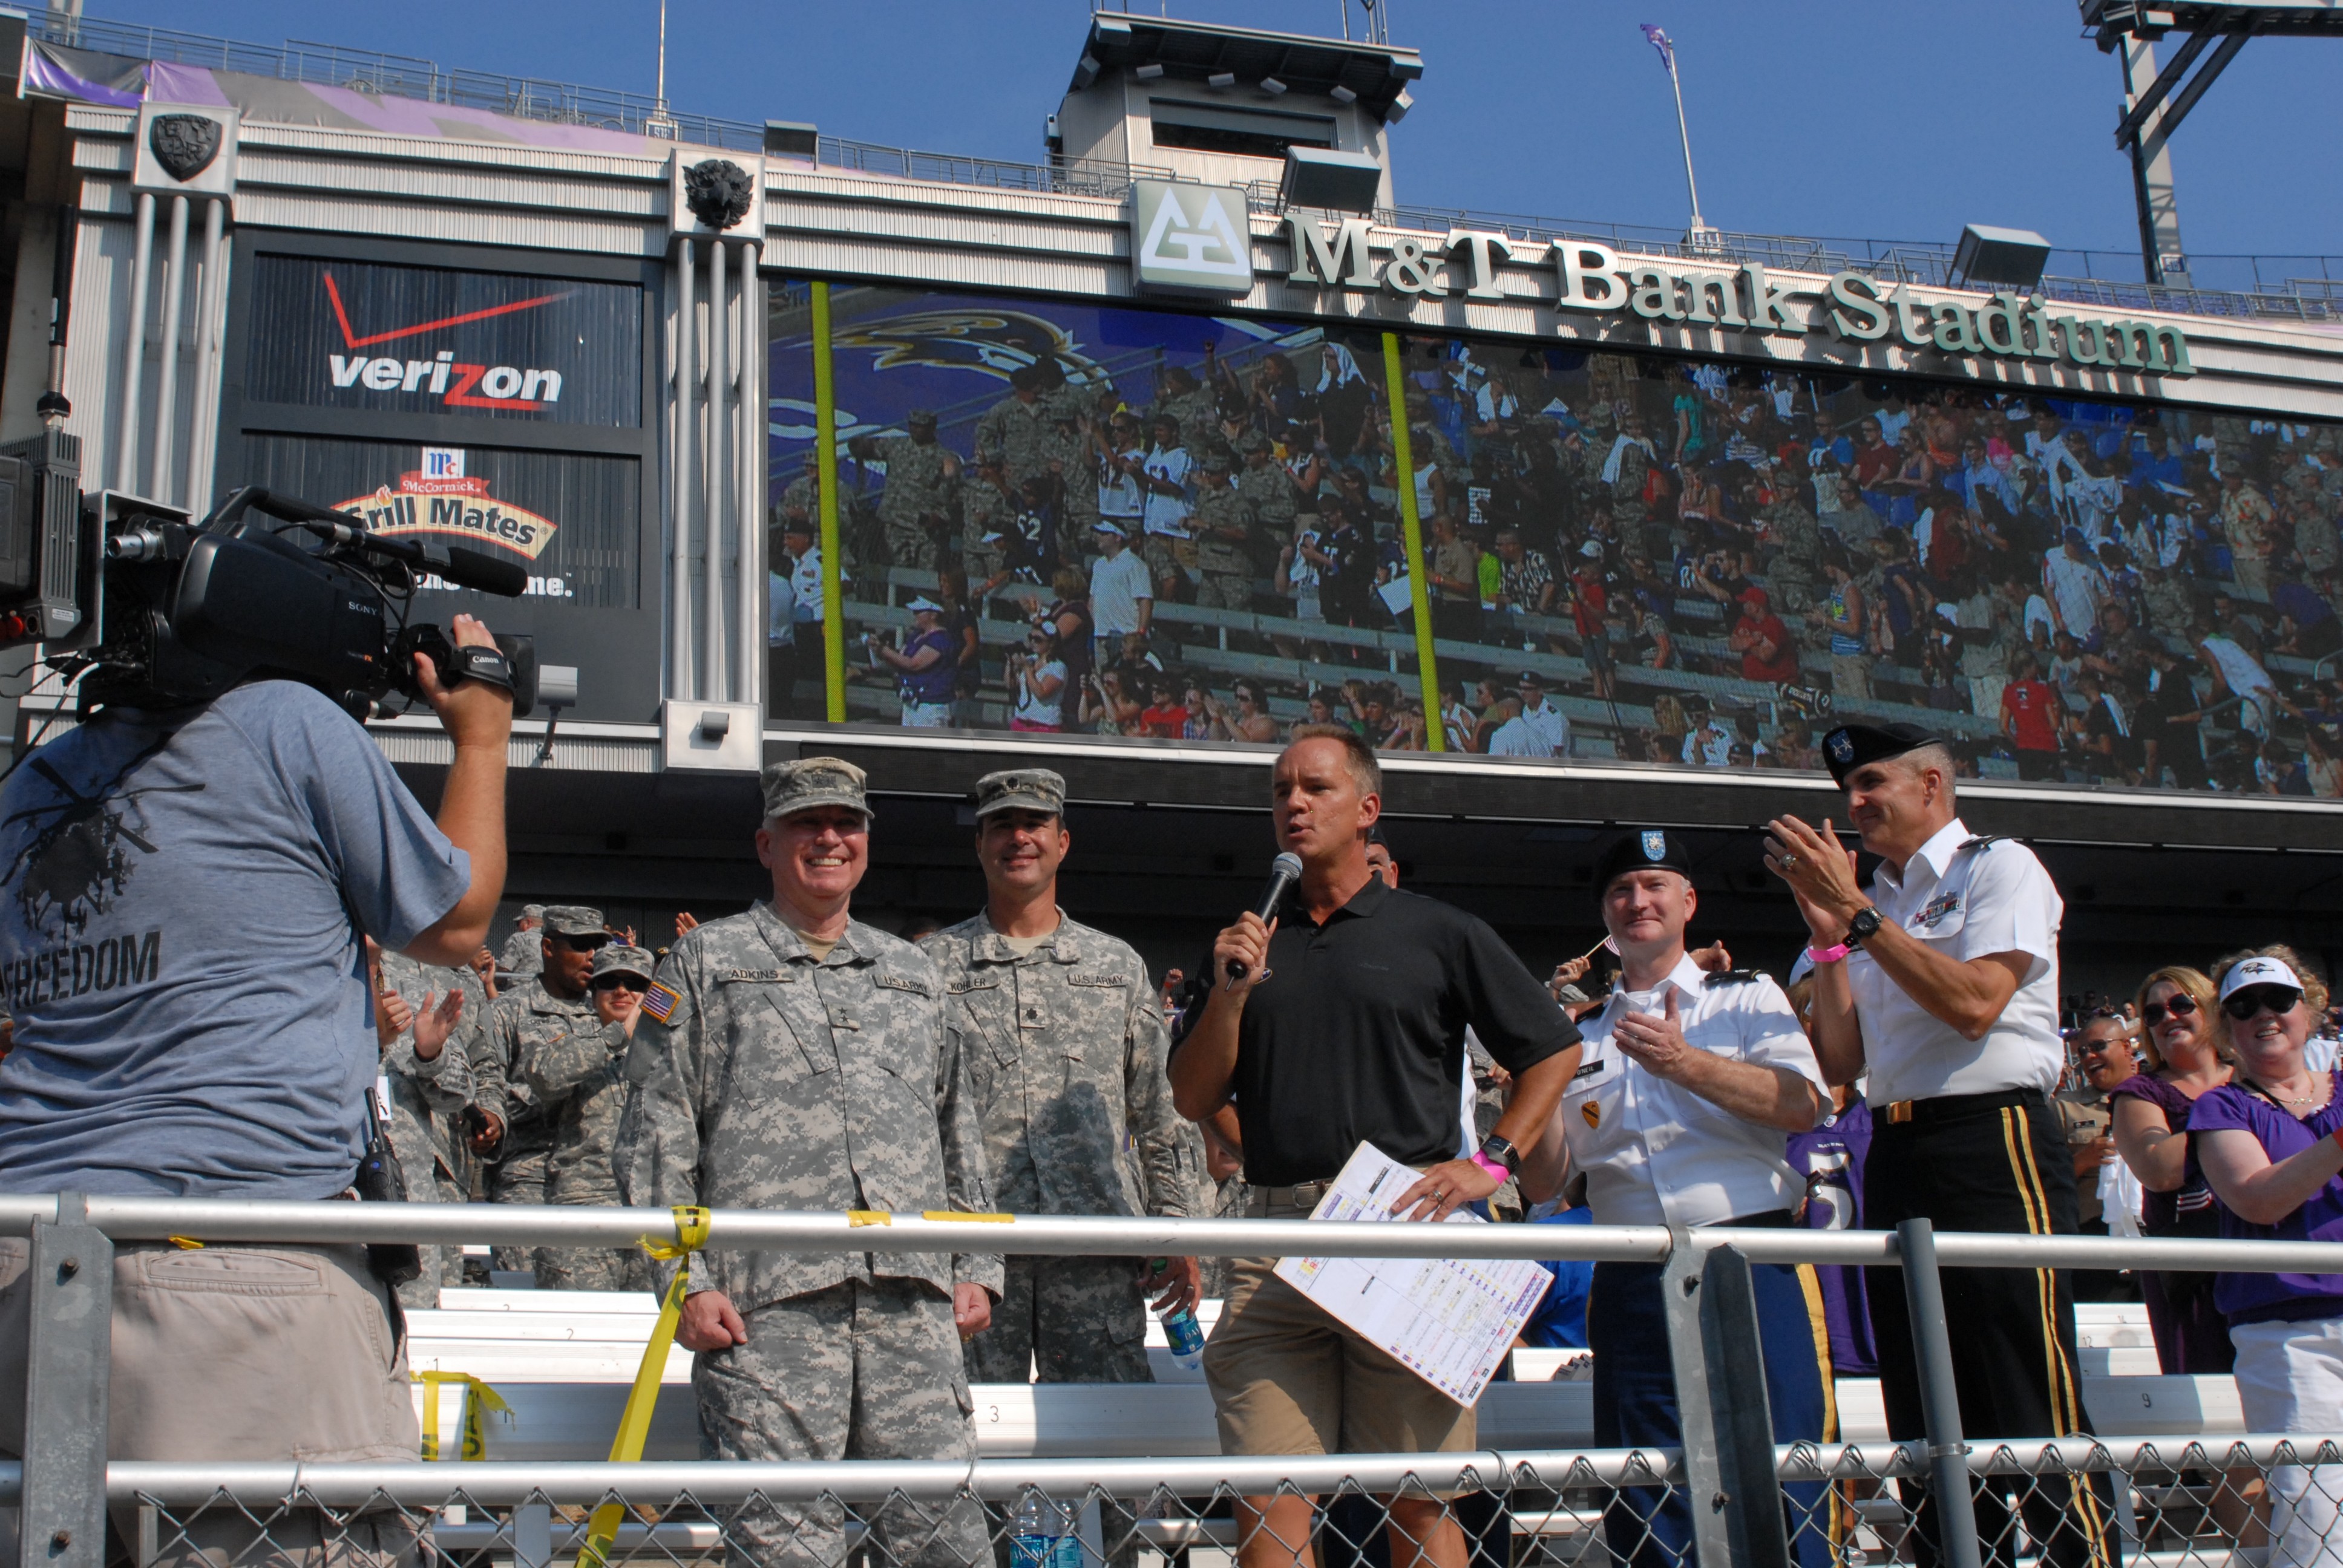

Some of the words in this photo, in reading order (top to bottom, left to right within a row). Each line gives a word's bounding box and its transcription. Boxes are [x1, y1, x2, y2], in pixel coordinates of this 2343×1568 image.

[1283, 212, 1513, 298] M&T
[1553, 240, 1808, 332] Bank
[1829, 271, 2196, 376] Stadium
[330, 351, 562, 410] verizon
[429, 497, 537, 545] Mates
[349, 601, 378, 615] SONY
[473, 655, 499, 664] Canon
[3, 932, 161, 1010] FREEDOM
[731, 969, 779, 979] ADKINS
[951, 978, 986, 991] KOHLER
[1073, 974, 1093, 984] U.S.
[1095, 975, 1123, 985] ARMY
[2141, 1393, 2151, 1408] 9
[989, 1405, 999, 1423] 3
